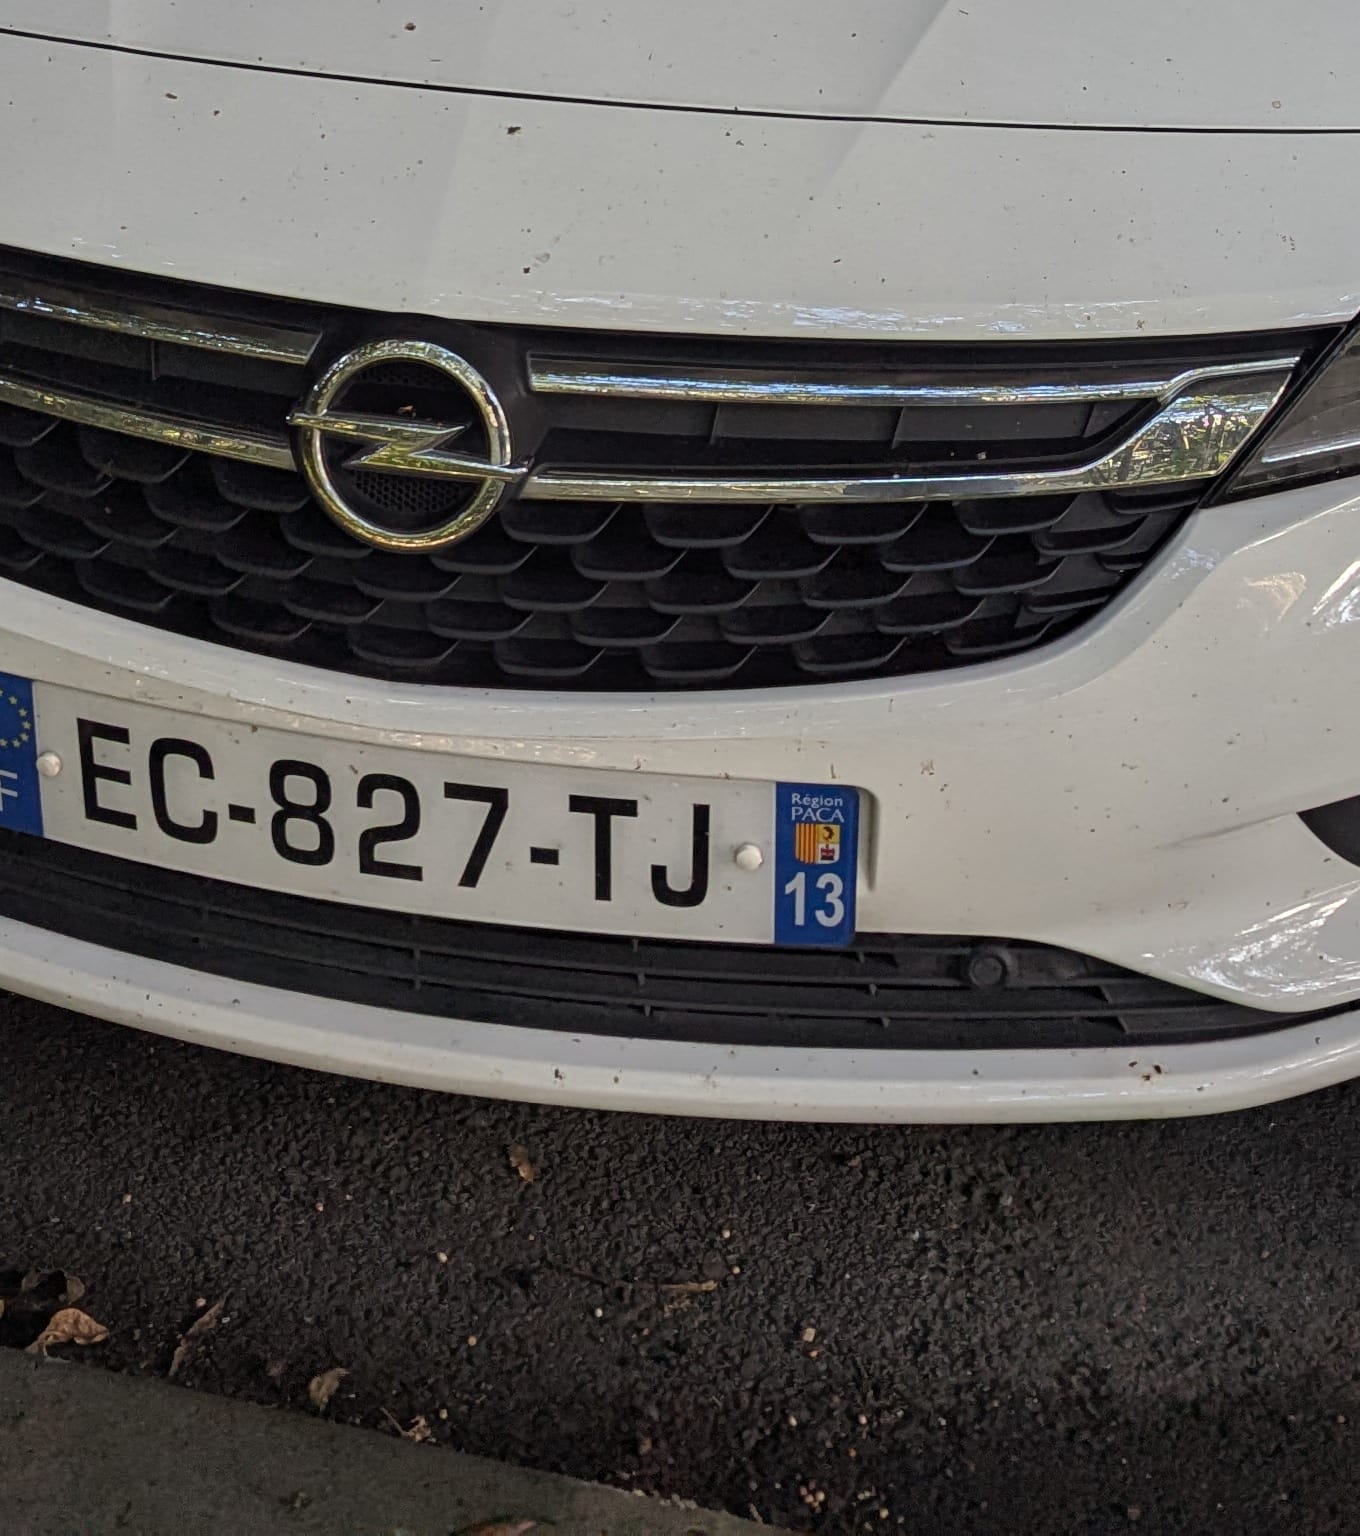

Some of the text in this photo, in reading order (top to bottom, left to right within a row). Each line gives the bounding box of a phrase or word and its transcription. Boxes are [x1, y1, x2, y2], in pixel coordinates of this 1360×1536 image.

[76, 717, 711, 908] EC-827-TJ
[791, 792, 844, 809] Région
[791, 806, 845, 823] PACA
[785, 871, 845, 927] 13
